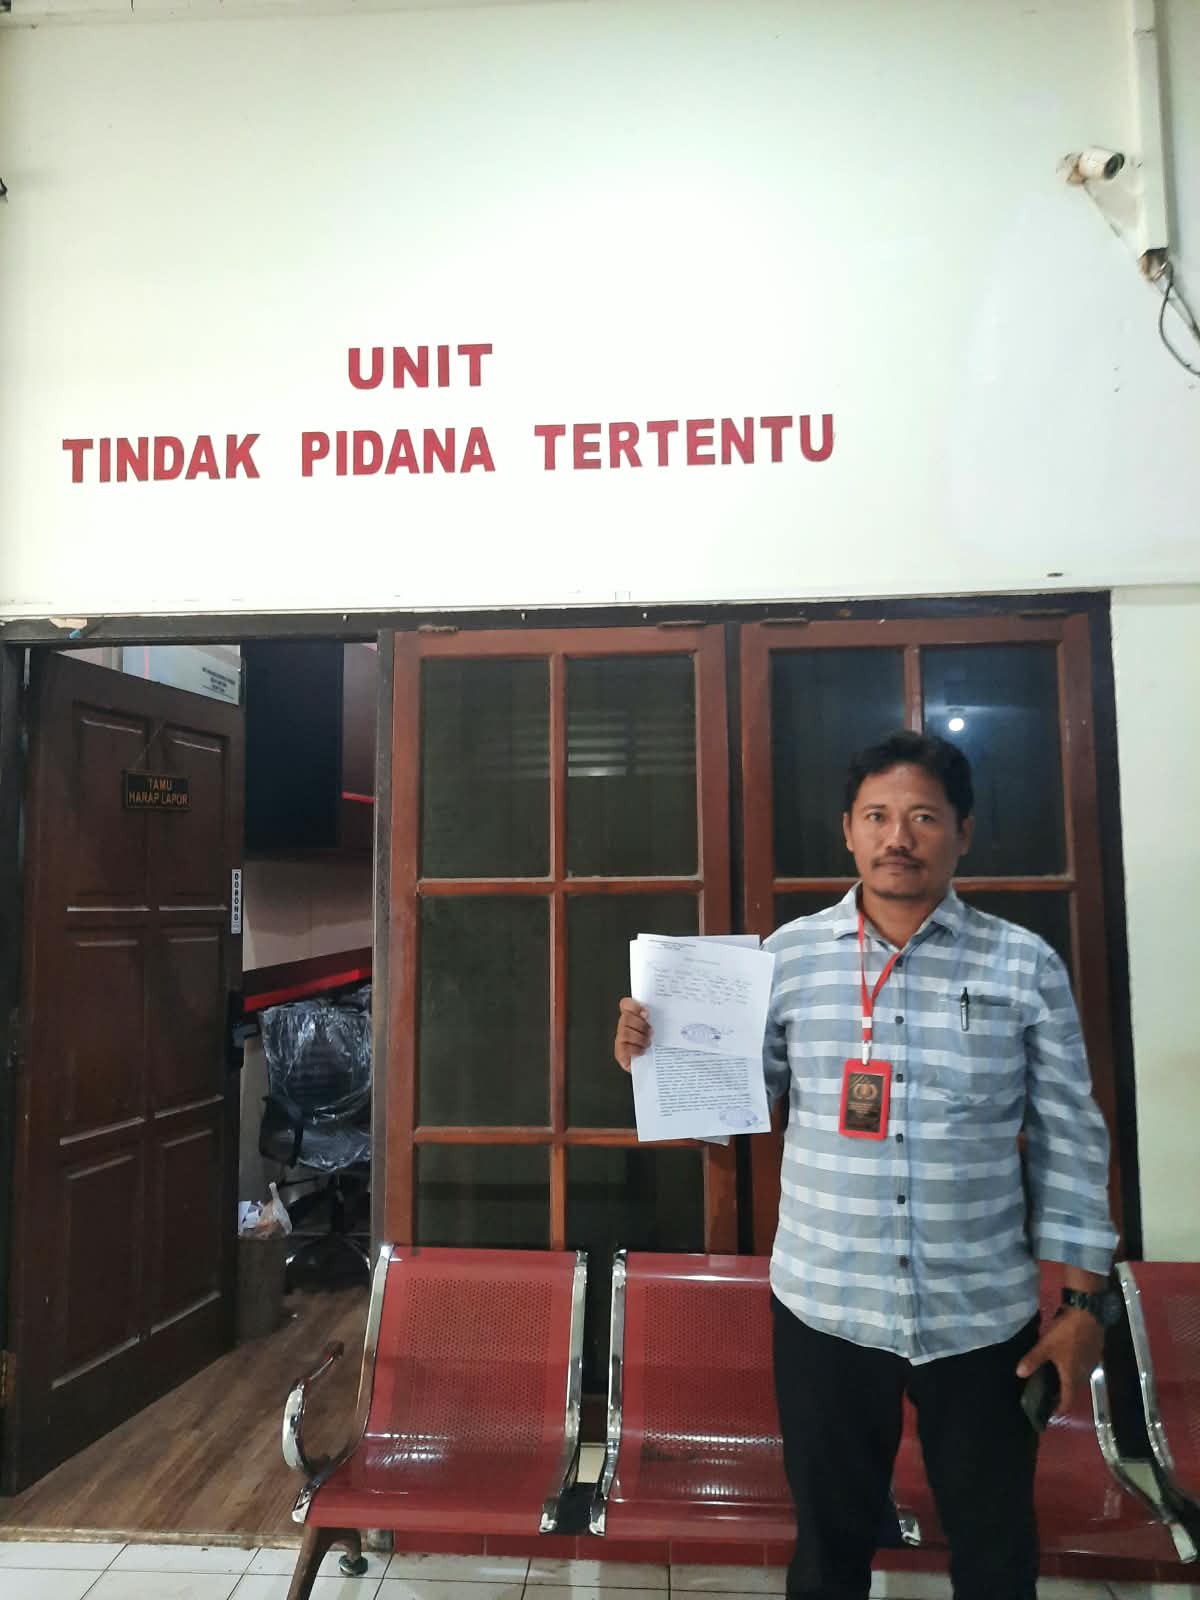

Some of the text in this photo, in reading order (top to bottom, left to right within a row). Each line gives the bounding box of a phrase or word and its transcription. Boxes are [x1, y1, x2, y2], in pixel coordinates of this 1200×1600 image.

[349, 344, 493, 390] UNIT
[63, 415, 834, 483] TINDAK PIDANA TERTENTU
[128, 791, 188, 806] HARAP LAPOR
[148, 777, 173, 791] TAMU
